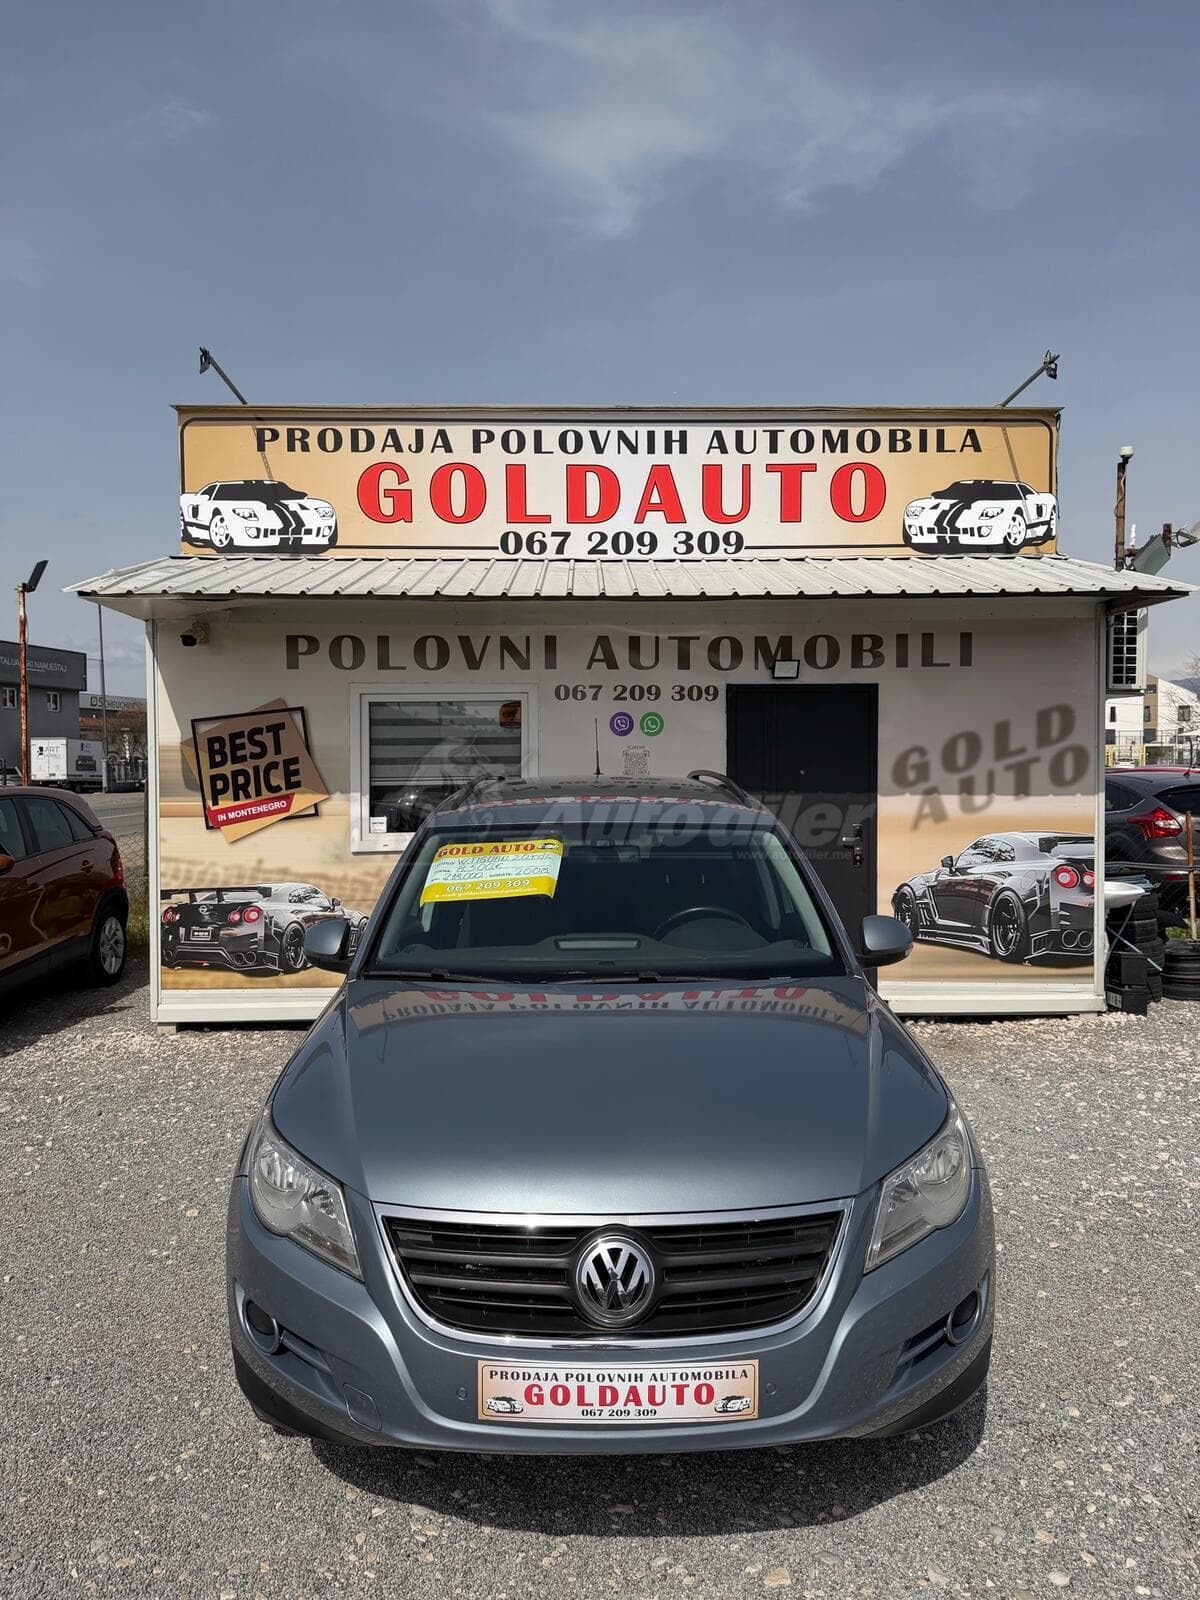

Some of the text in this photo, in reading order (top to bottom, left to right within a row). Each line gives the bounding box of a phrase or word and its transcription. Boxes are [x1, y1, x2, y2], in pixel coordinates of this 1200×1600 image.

[256, 427, 983, 455] PRODAJA POLOVNIH AUTOMOBILA
[356, 462, 887, 524] GOLDAUTO
[499, 529, 745, 556] 067 209 309
[285, 632, 973, 671] POLOVNI AUTOMOBILI
[554, 683, 719, 702] 067 209 309
[206, 722, 286, 769] BEST
[892, 703, 1076, 789] GOLD
[209, 756, 302, 806] PRICE
[911, 743, 1090, 832] AUTO
[217, 800, 287, 822] IN MONTENEGRO
[437, 843, 536, 858] GOLD AUTO
[446, 879, 530, 892] 067 209 309
[489, 1368, 749, 1383] PRODAJA POLOVNIH AUTOMOBILA
[524, 1382, 715, 1407] GOLDAUTO
[581, 1408, 657, 1417] 067 209 309
